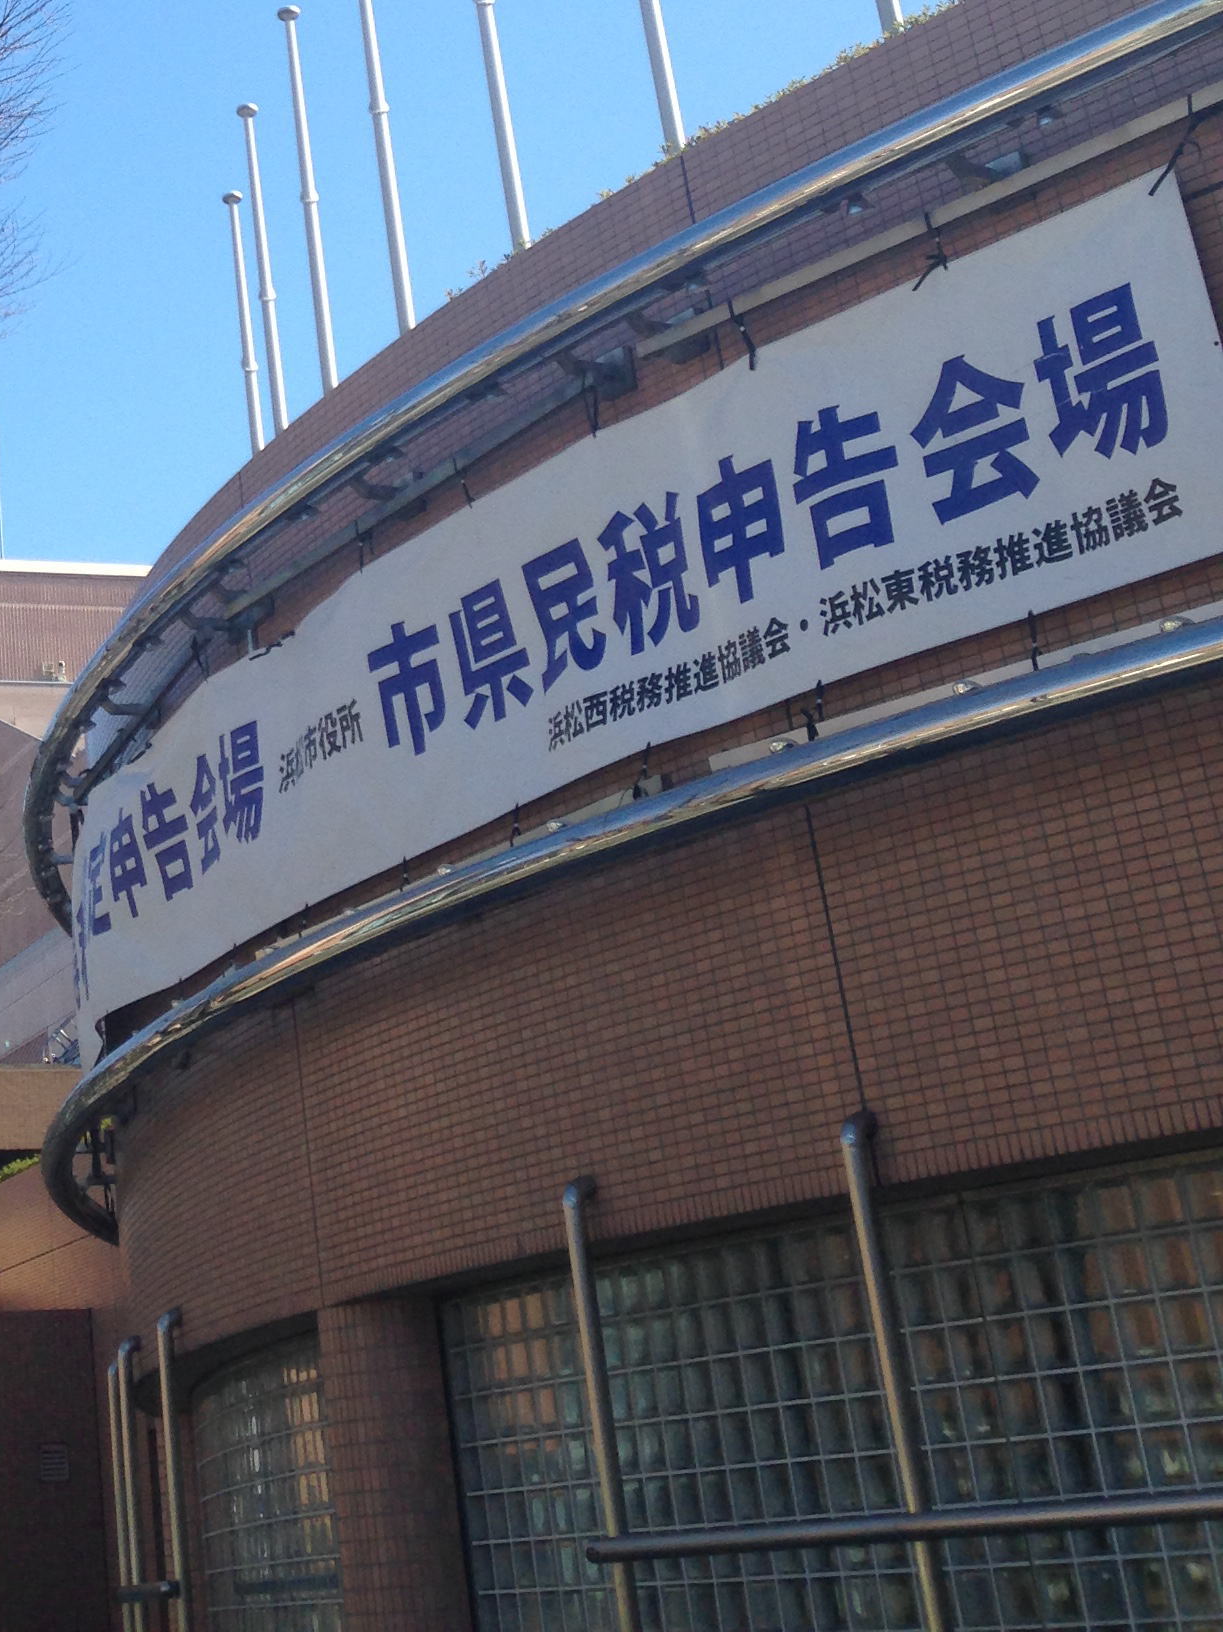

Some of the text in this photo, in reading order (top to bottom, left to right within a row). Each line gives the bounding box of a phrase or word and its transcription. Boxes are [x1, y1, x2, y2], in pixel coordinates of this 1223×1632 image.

[368, 282, 1168, 756] 市県民税申告会場
